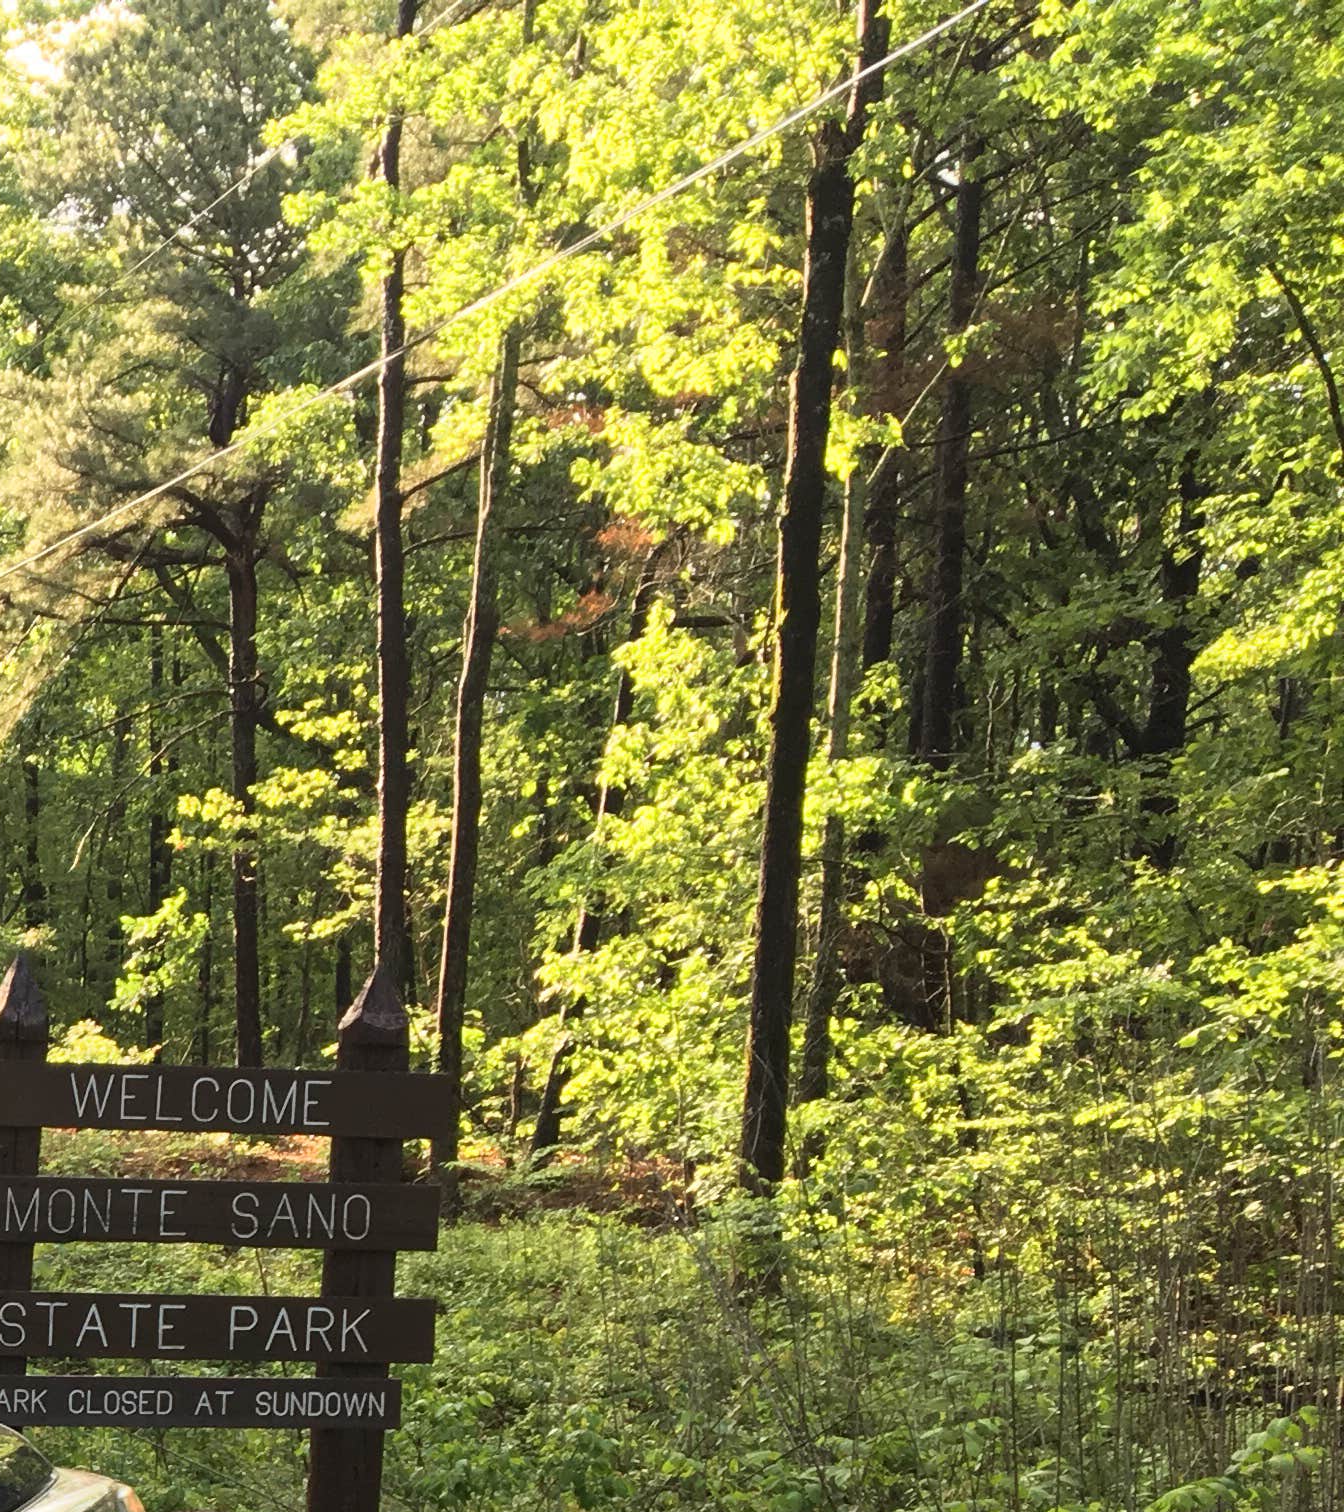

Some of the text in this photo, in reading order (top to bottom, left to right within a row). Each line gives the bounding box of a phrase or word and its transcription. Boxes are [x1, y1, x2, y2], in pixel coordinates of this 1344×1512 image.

[70, 1072, 333, 1126] WELCOME
[4, 1186, 371, 1241] MONTE SANO
[229, 1305, 371, 1353] PARK
[68, 1389, 173, 1416] CLOSED
[194, 1390, 235, 1416] AT
[255, 1391, 386, 1418] SUNDOWN
